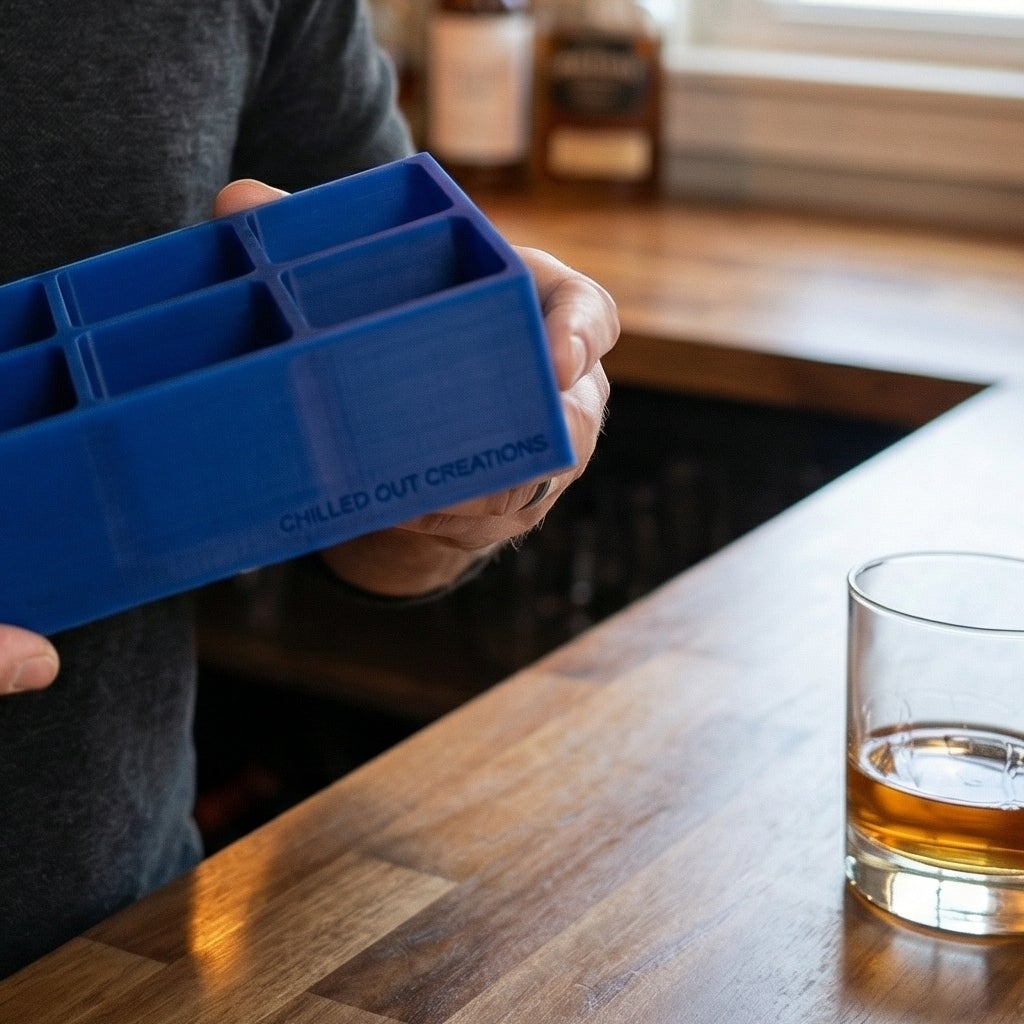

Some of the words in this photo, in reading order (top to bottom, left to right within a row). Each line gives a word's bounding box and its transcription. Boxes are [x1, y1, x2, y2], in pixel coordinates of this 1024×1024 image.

[279, 491, 370, 533] CHILLED
[374, 474, 419, 503] OUT
[426, 434, 549, 486] CREATIONS
